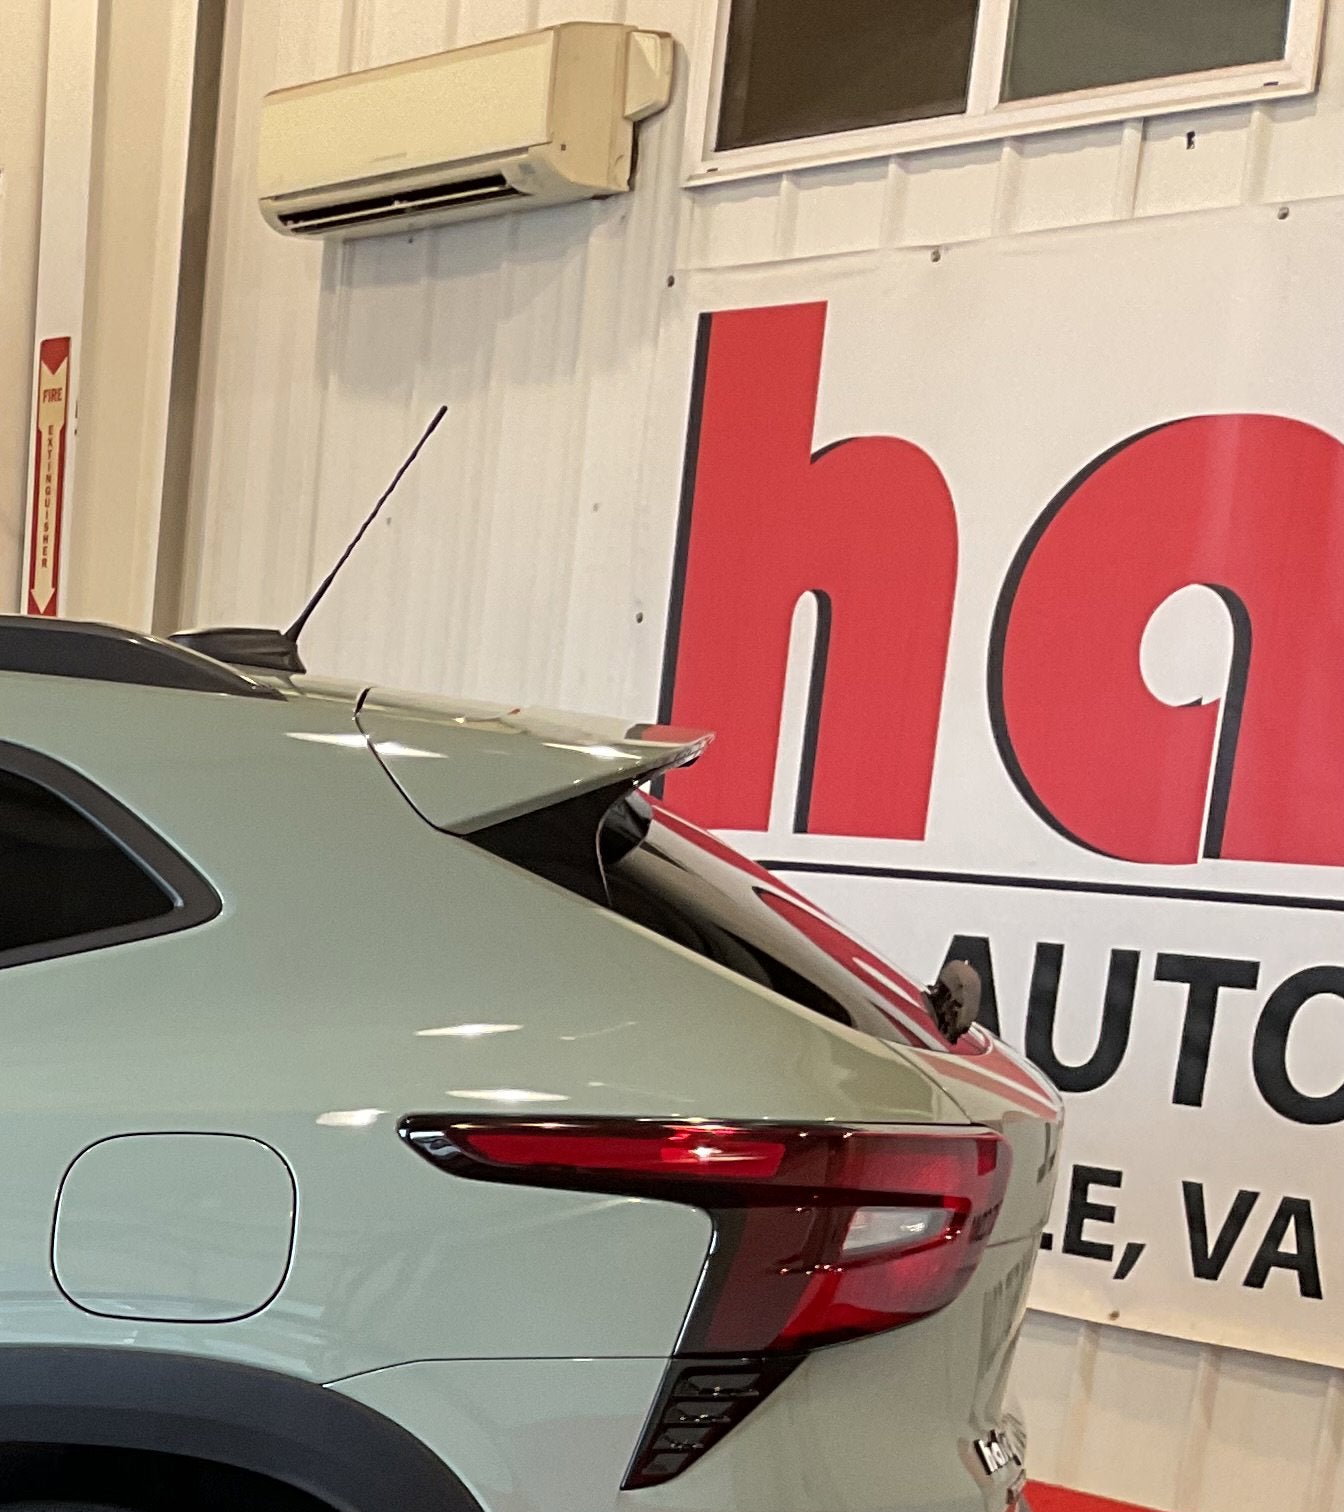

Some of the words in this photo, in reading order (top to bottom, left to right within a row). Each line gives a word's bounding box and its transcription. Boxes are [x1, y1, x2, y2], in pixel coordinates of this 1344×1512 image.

[43, 387, 63, 403] FIRE
[41, 425, 54, 568] EXTINGUISHER
[1182, 1180, 1323, 1299] VA
